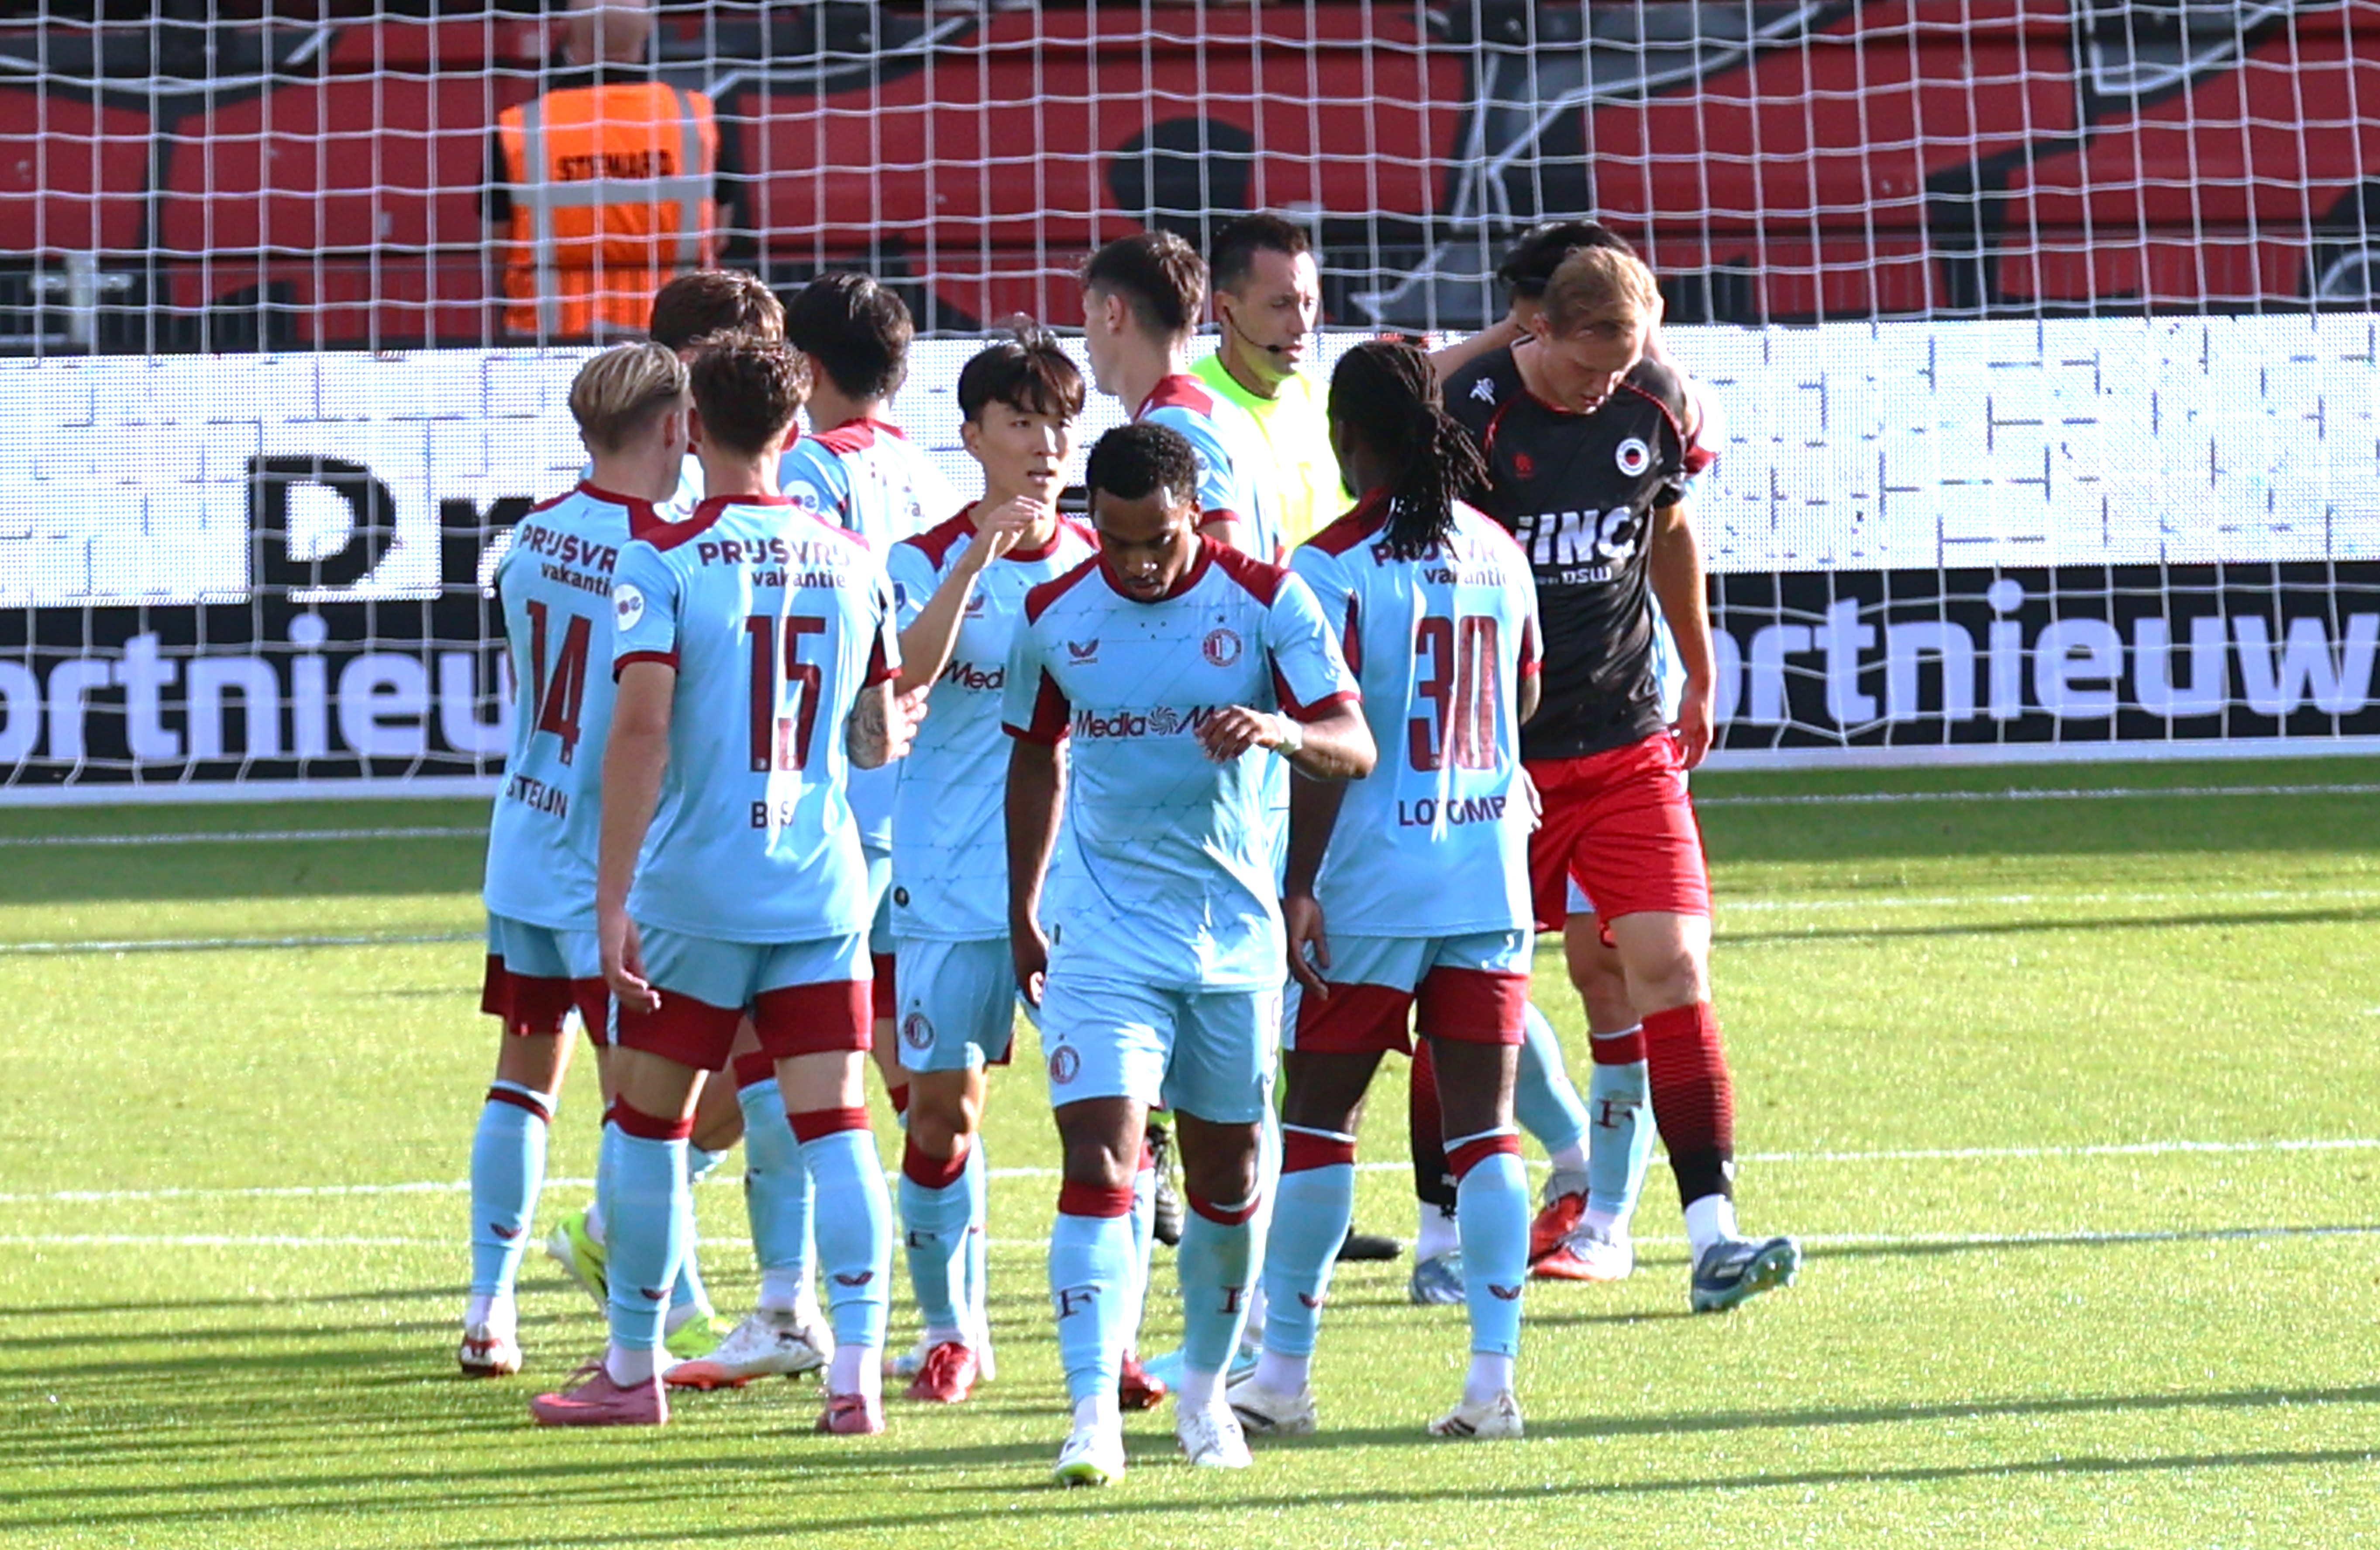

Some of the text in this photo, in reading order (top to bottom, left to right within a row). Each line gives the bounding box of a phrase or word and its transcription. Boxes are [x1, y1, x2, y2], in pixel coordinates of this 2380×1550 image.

[541, 562, 613, 598] vakanti
[527, 598, 592, 766] 14
[744, 615, 826, 772] 15
[939, 660, 1006, 690] Med
[1409, 615, 1498, 772] 30
